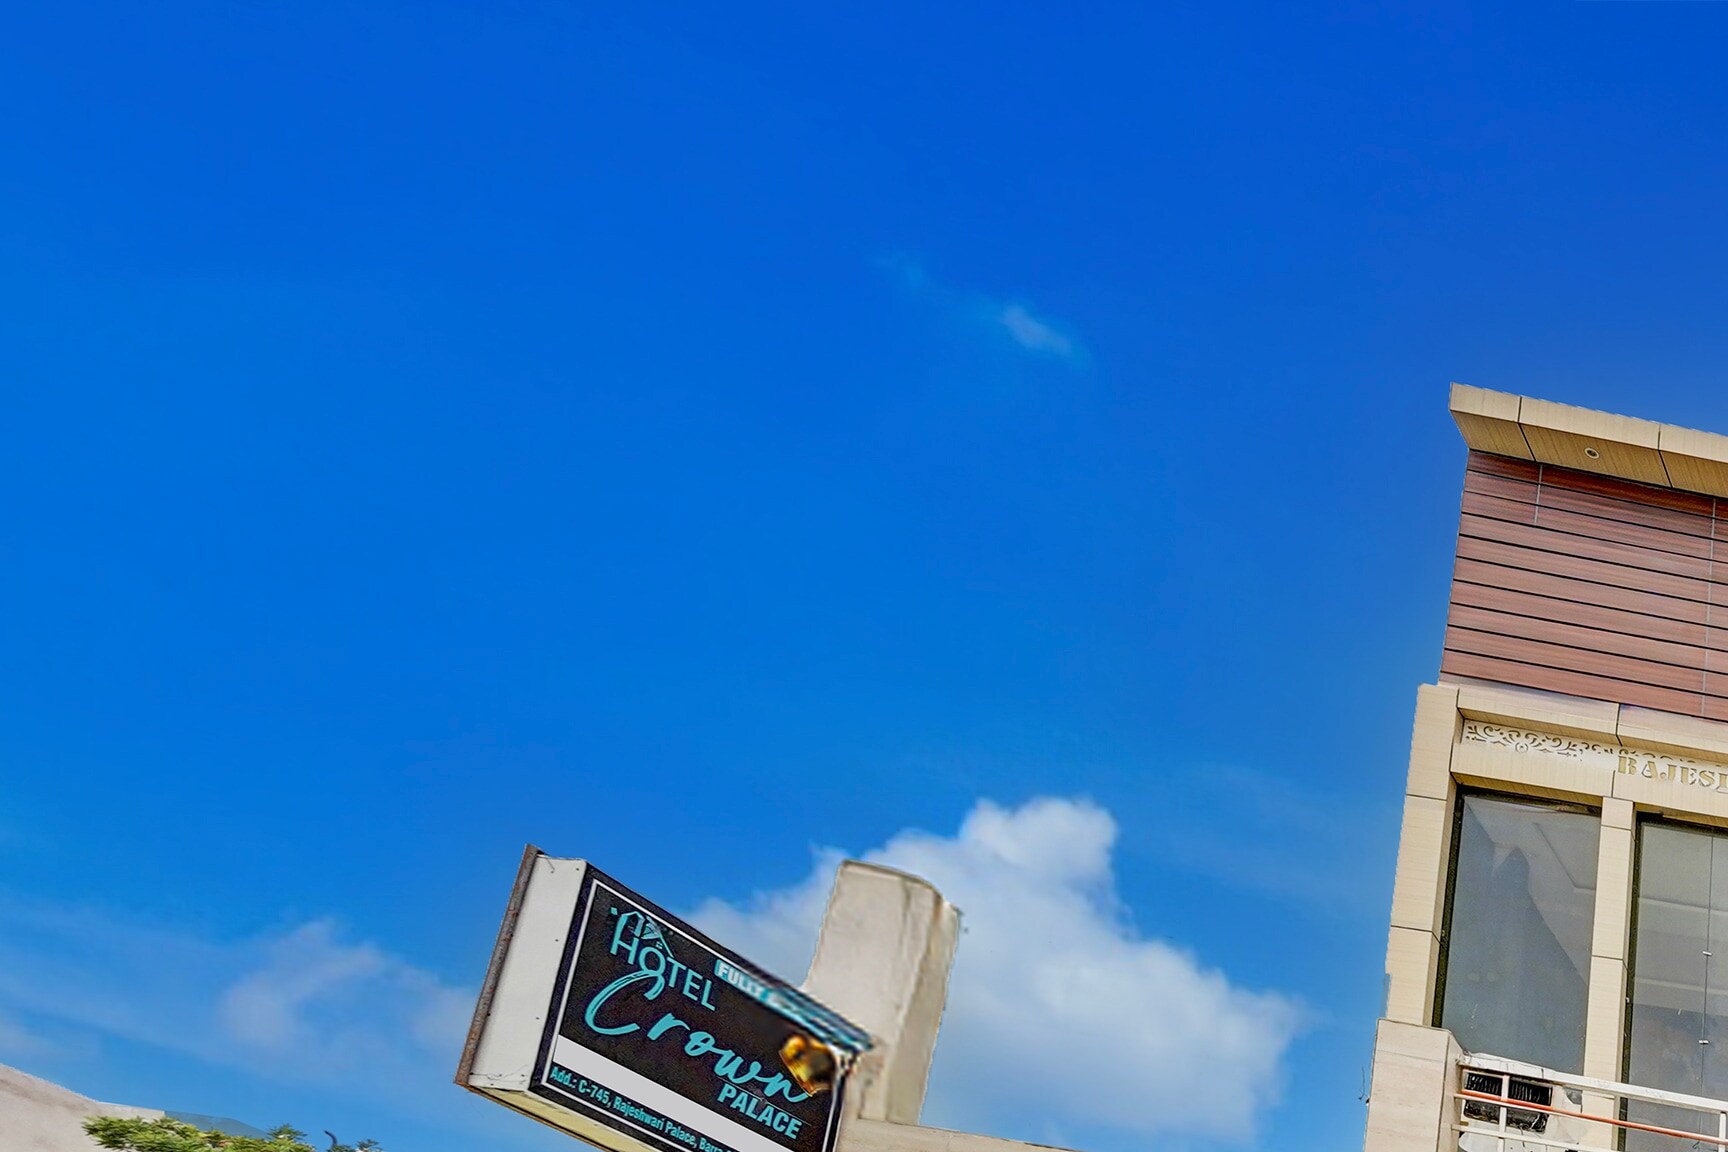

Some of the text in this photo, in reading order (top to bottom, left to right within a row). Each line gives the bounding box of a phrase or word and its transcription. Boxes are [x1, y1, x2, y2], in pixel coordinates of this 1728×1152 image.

[610, 914, 716, 1011] HOTEL
[584, 969, 810, 1103] Crown
[580, 1079, 612, 1108] C-745,
[613, 1096, 665, 1131] Rajeshwari
[665, 1121, 698, 1149] Palace,
[717, 1083, 802, 1139] PALACE
